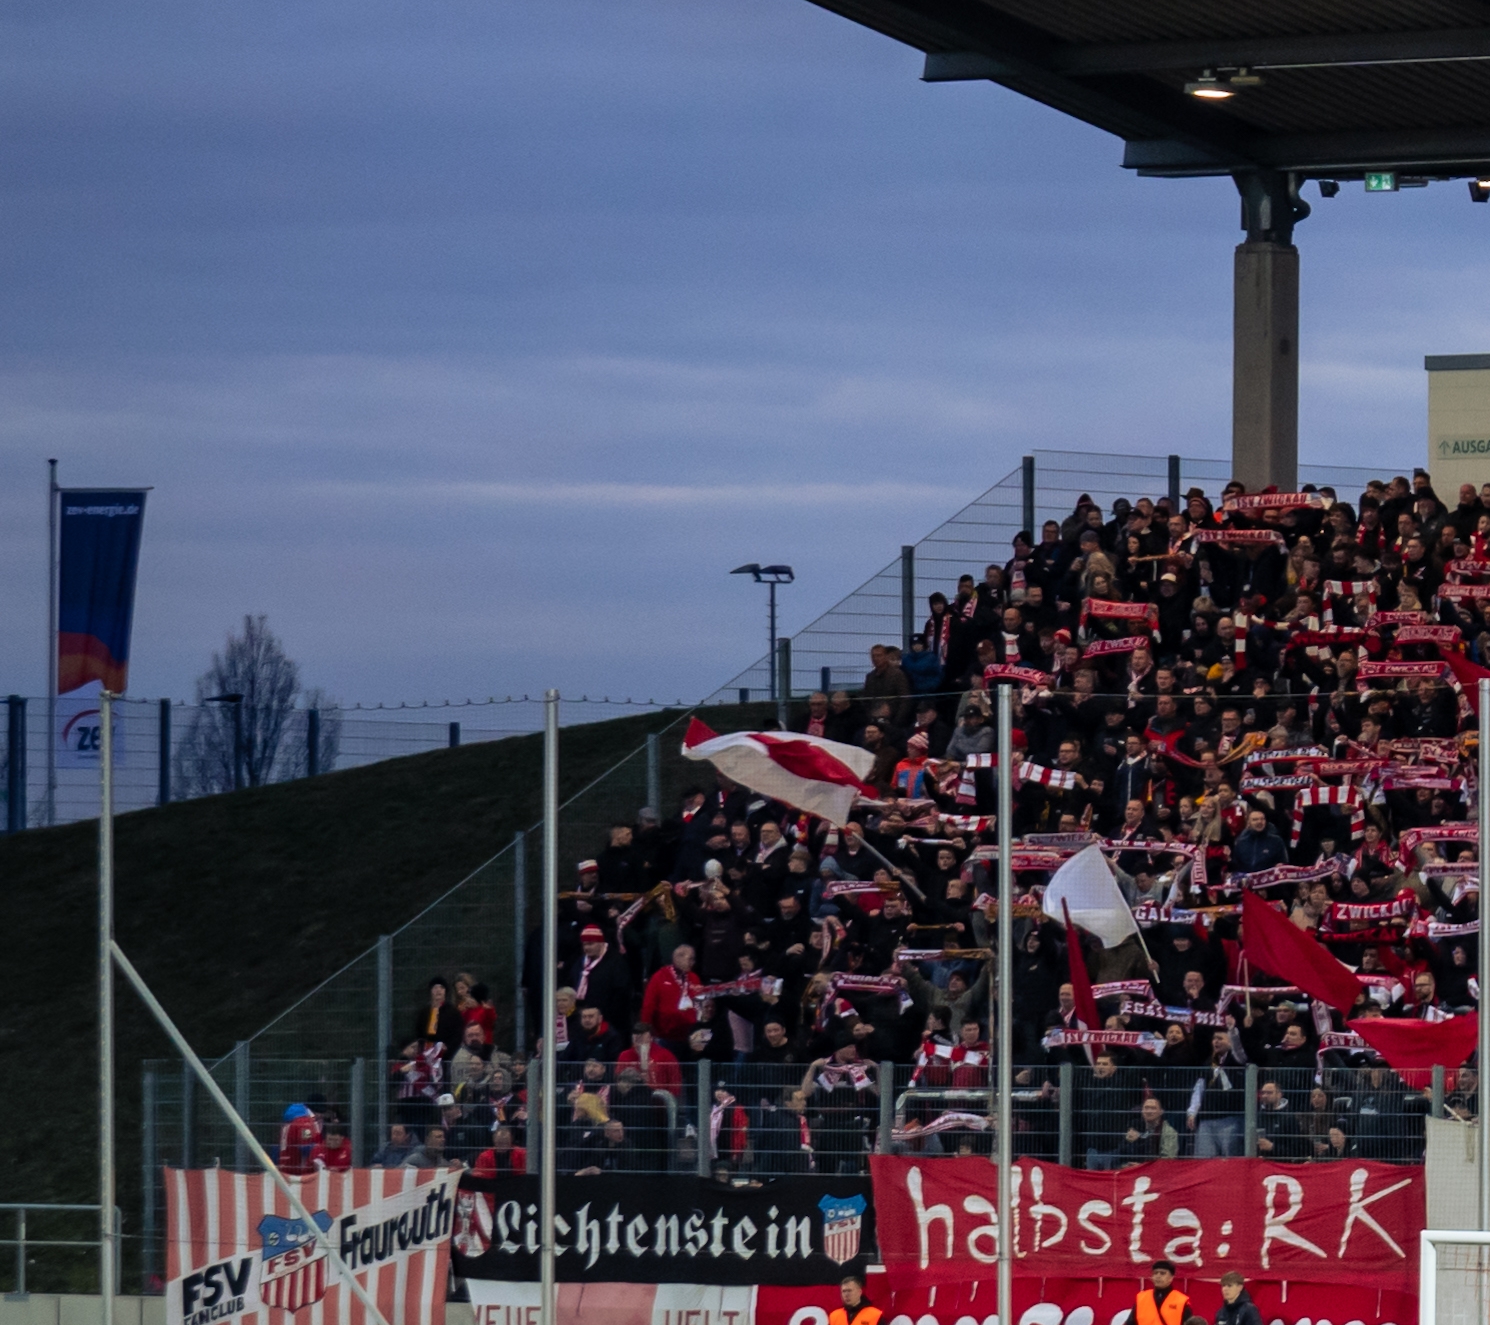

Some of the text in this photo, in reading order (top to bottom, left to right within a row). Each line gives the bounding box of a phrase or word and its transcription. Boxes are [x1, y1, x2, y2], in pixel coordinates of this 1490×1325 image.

[77, 726, 100, 751] ze
[268, 1239, 318, 1275] FSV
[498, 1199, 814, 1270] Lichtenstein
[182, 1257, 253, 1317] FSV
